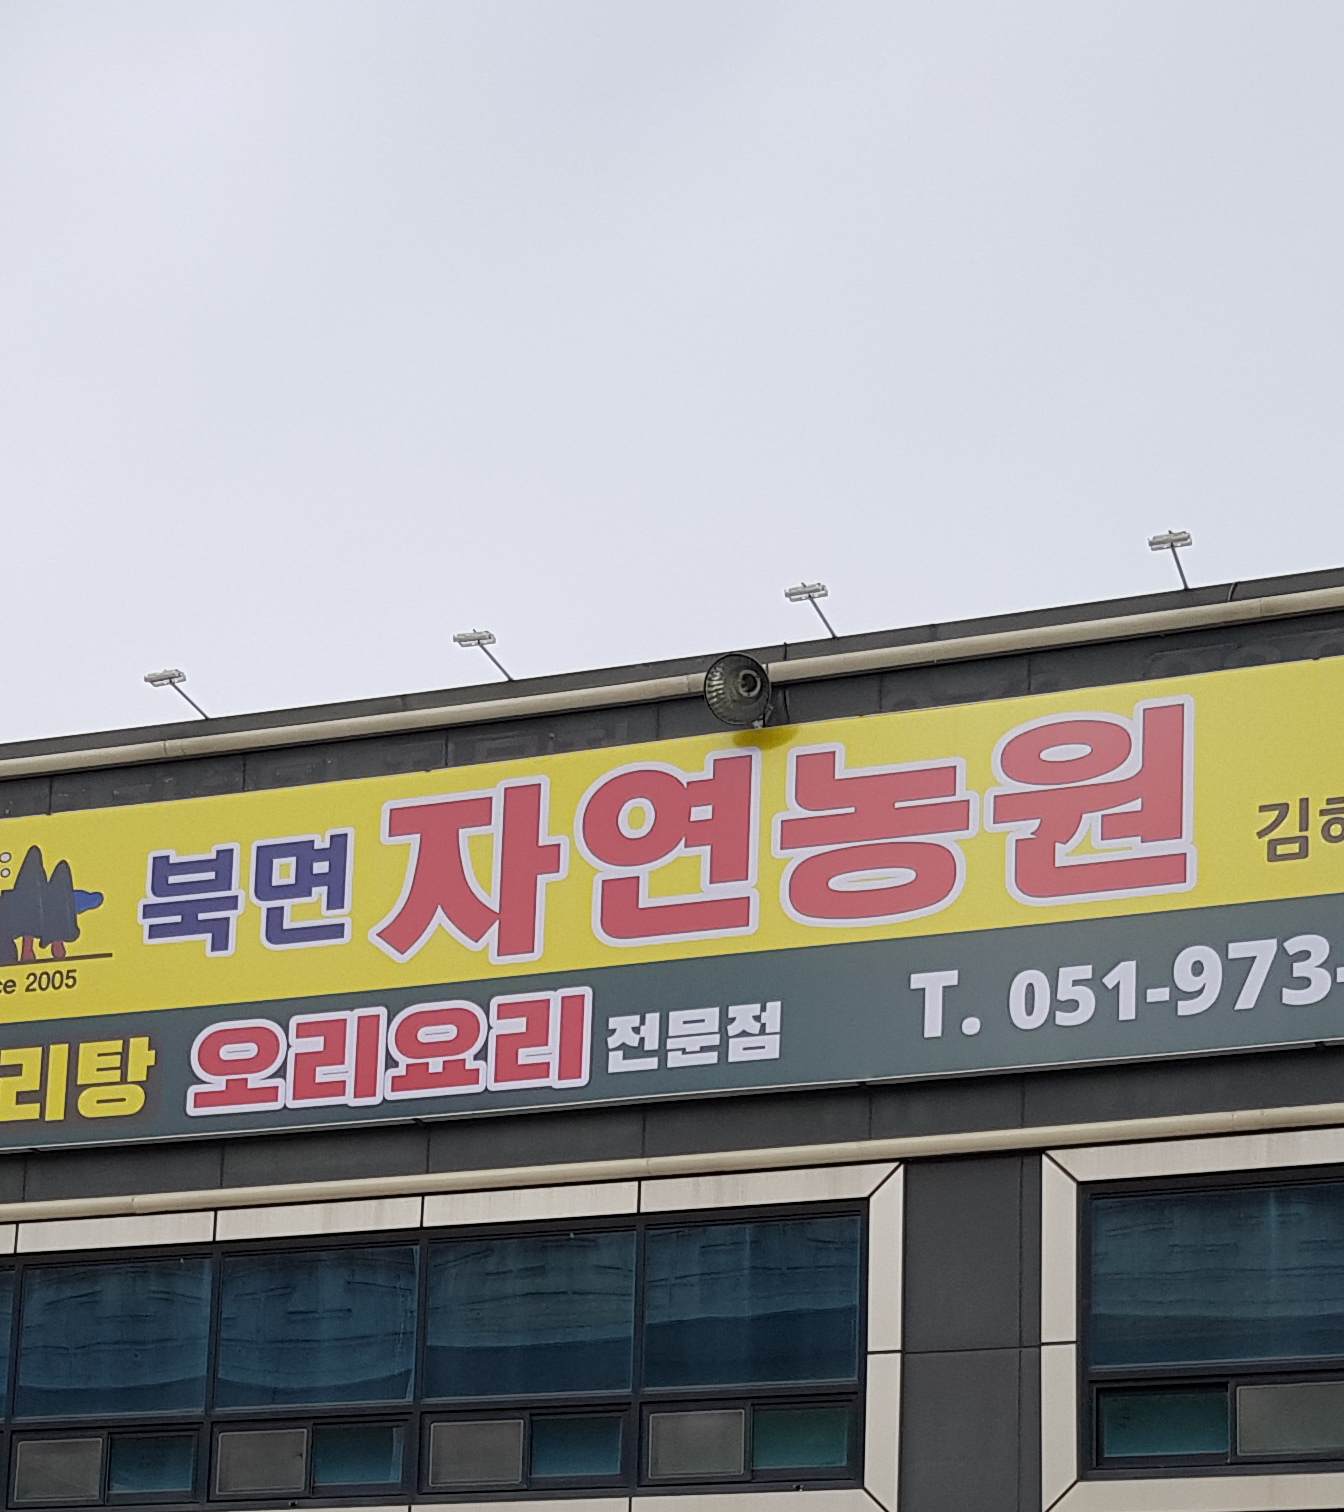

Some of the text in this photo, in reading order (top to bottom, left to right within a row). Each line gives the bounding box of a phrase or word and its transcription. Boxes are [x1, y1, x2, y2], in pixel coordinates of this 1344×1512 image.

[140, 830, 352, 954] 북면
[373, 699, 1192, 961] 자연농원
[24, 970, 78, 995] 2005
[910, 969, 982, 1039] T.
[189, 990, 590, 1113] 오리요리
[605, 1000, 782, 1075] 전문점
